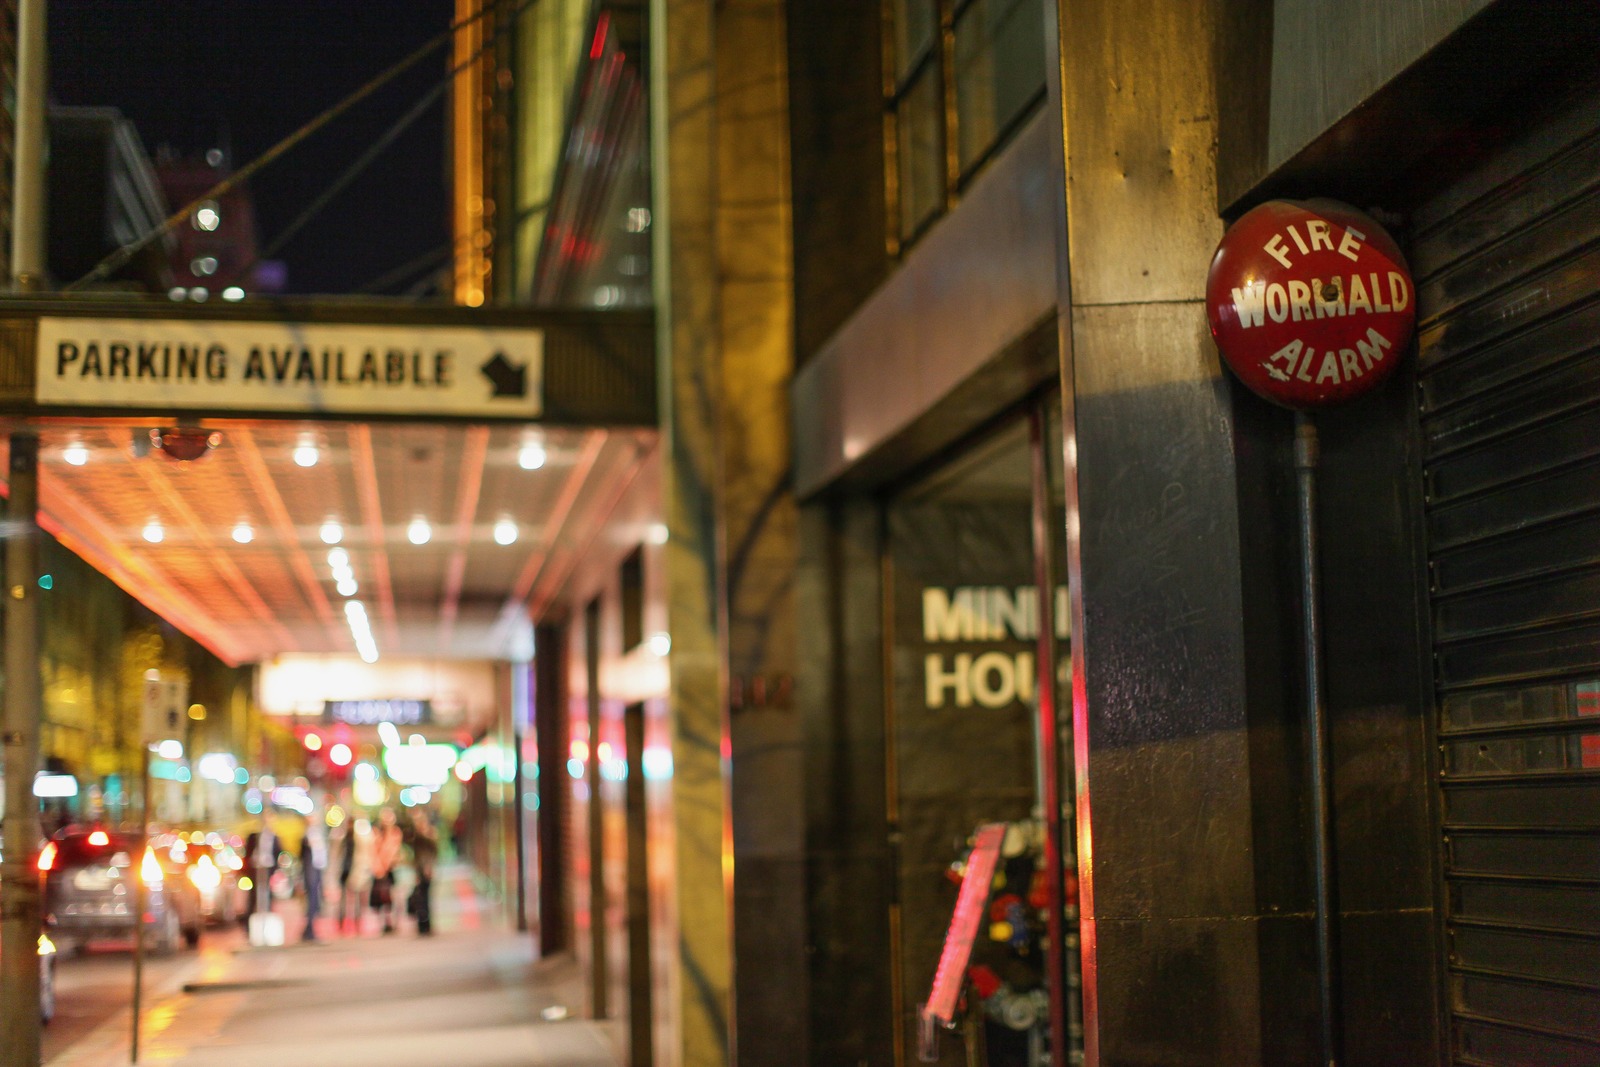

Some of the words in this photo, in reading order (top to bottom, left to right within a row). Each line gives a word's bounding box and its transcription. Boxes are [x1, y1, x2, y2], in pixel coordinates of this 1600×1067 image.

[1263, 219, 1366, 270] FIRE
[1231, 270, 1409, 329] WORMALD
[56, 341, 228, 381] PARKING
[244, 346, 454, 385] AVAILABLE
[1269, 327, 1392, 385] ALARM
